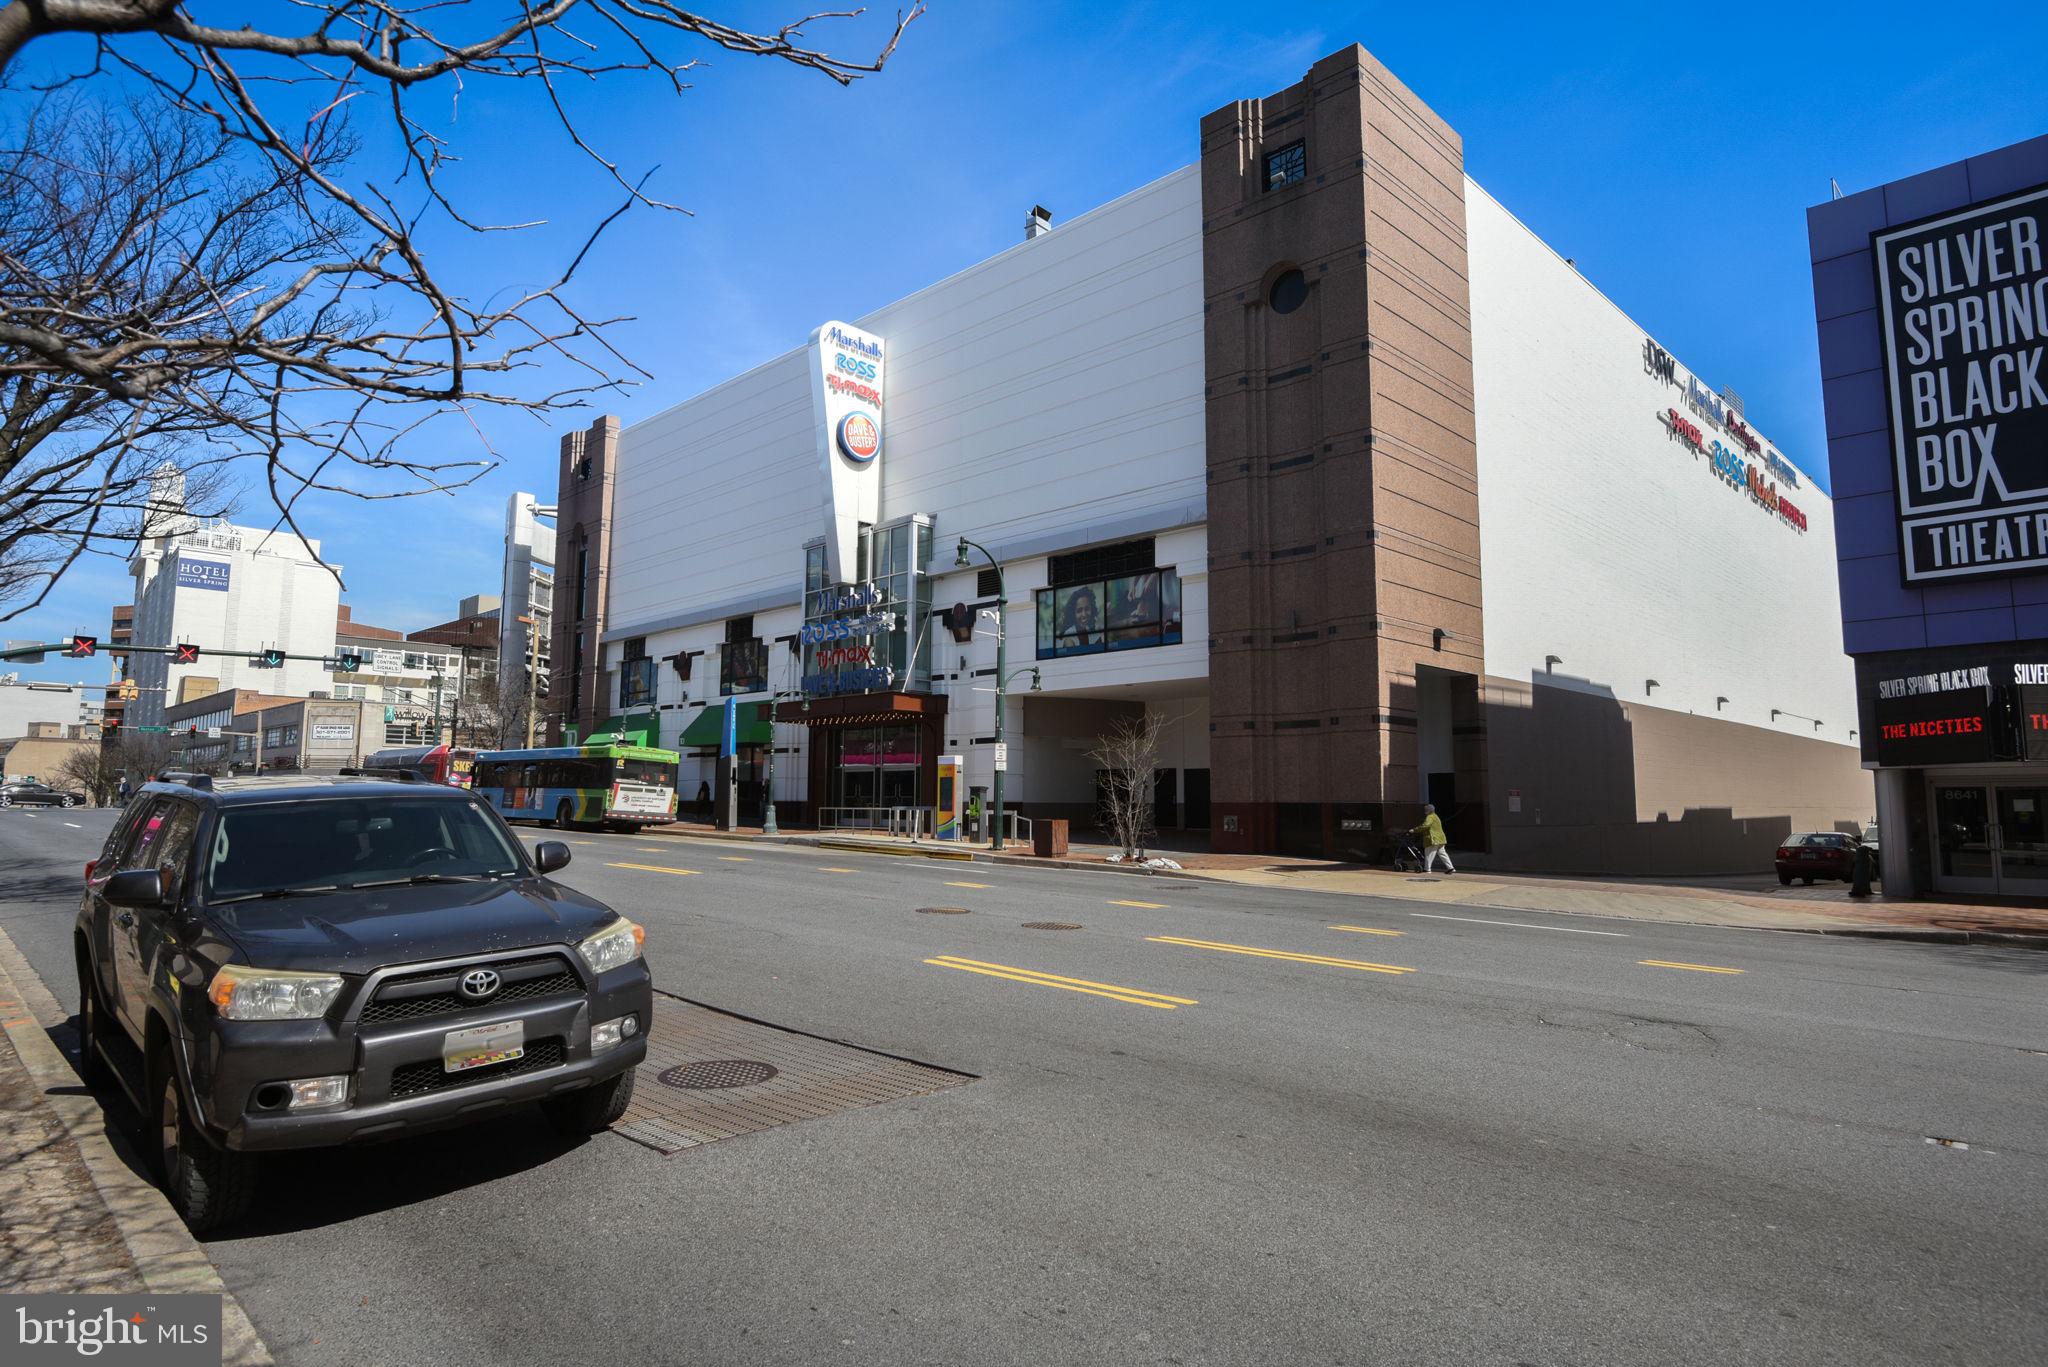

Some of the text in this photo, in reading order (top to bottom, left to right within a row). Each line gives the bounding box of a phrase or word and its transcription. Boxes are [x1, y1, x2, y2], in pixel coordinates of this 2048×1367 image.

[1898, 215, 2042, 303] SILVER
[824, 326, 883, 359] Marshalls
[835, 352, 876, 380] ROSS
[1911, 346, 2048, 429] BLACK
[847, 424, 875, 437] DAVE &
[1708, 439, 1746, 486] ROSS
[1916, 423, 2004, 500] BOX
[1928, 513, 2048, 567] THEATR
[180, 563, 228, 577] HOTEL
[203, 579, 228, 587] SPRING
[814, 584, 881, 615] Marshalls
[801, 617, 850, 645] ROSS
[1880, 666, 1991, 699] SILVER SPRING BLACK BOX
[1882, 716, 1983, 739] THE NICETIES
[453, 760, 474, 772] SKE
[1945, 791, 1977, 800] 8641
